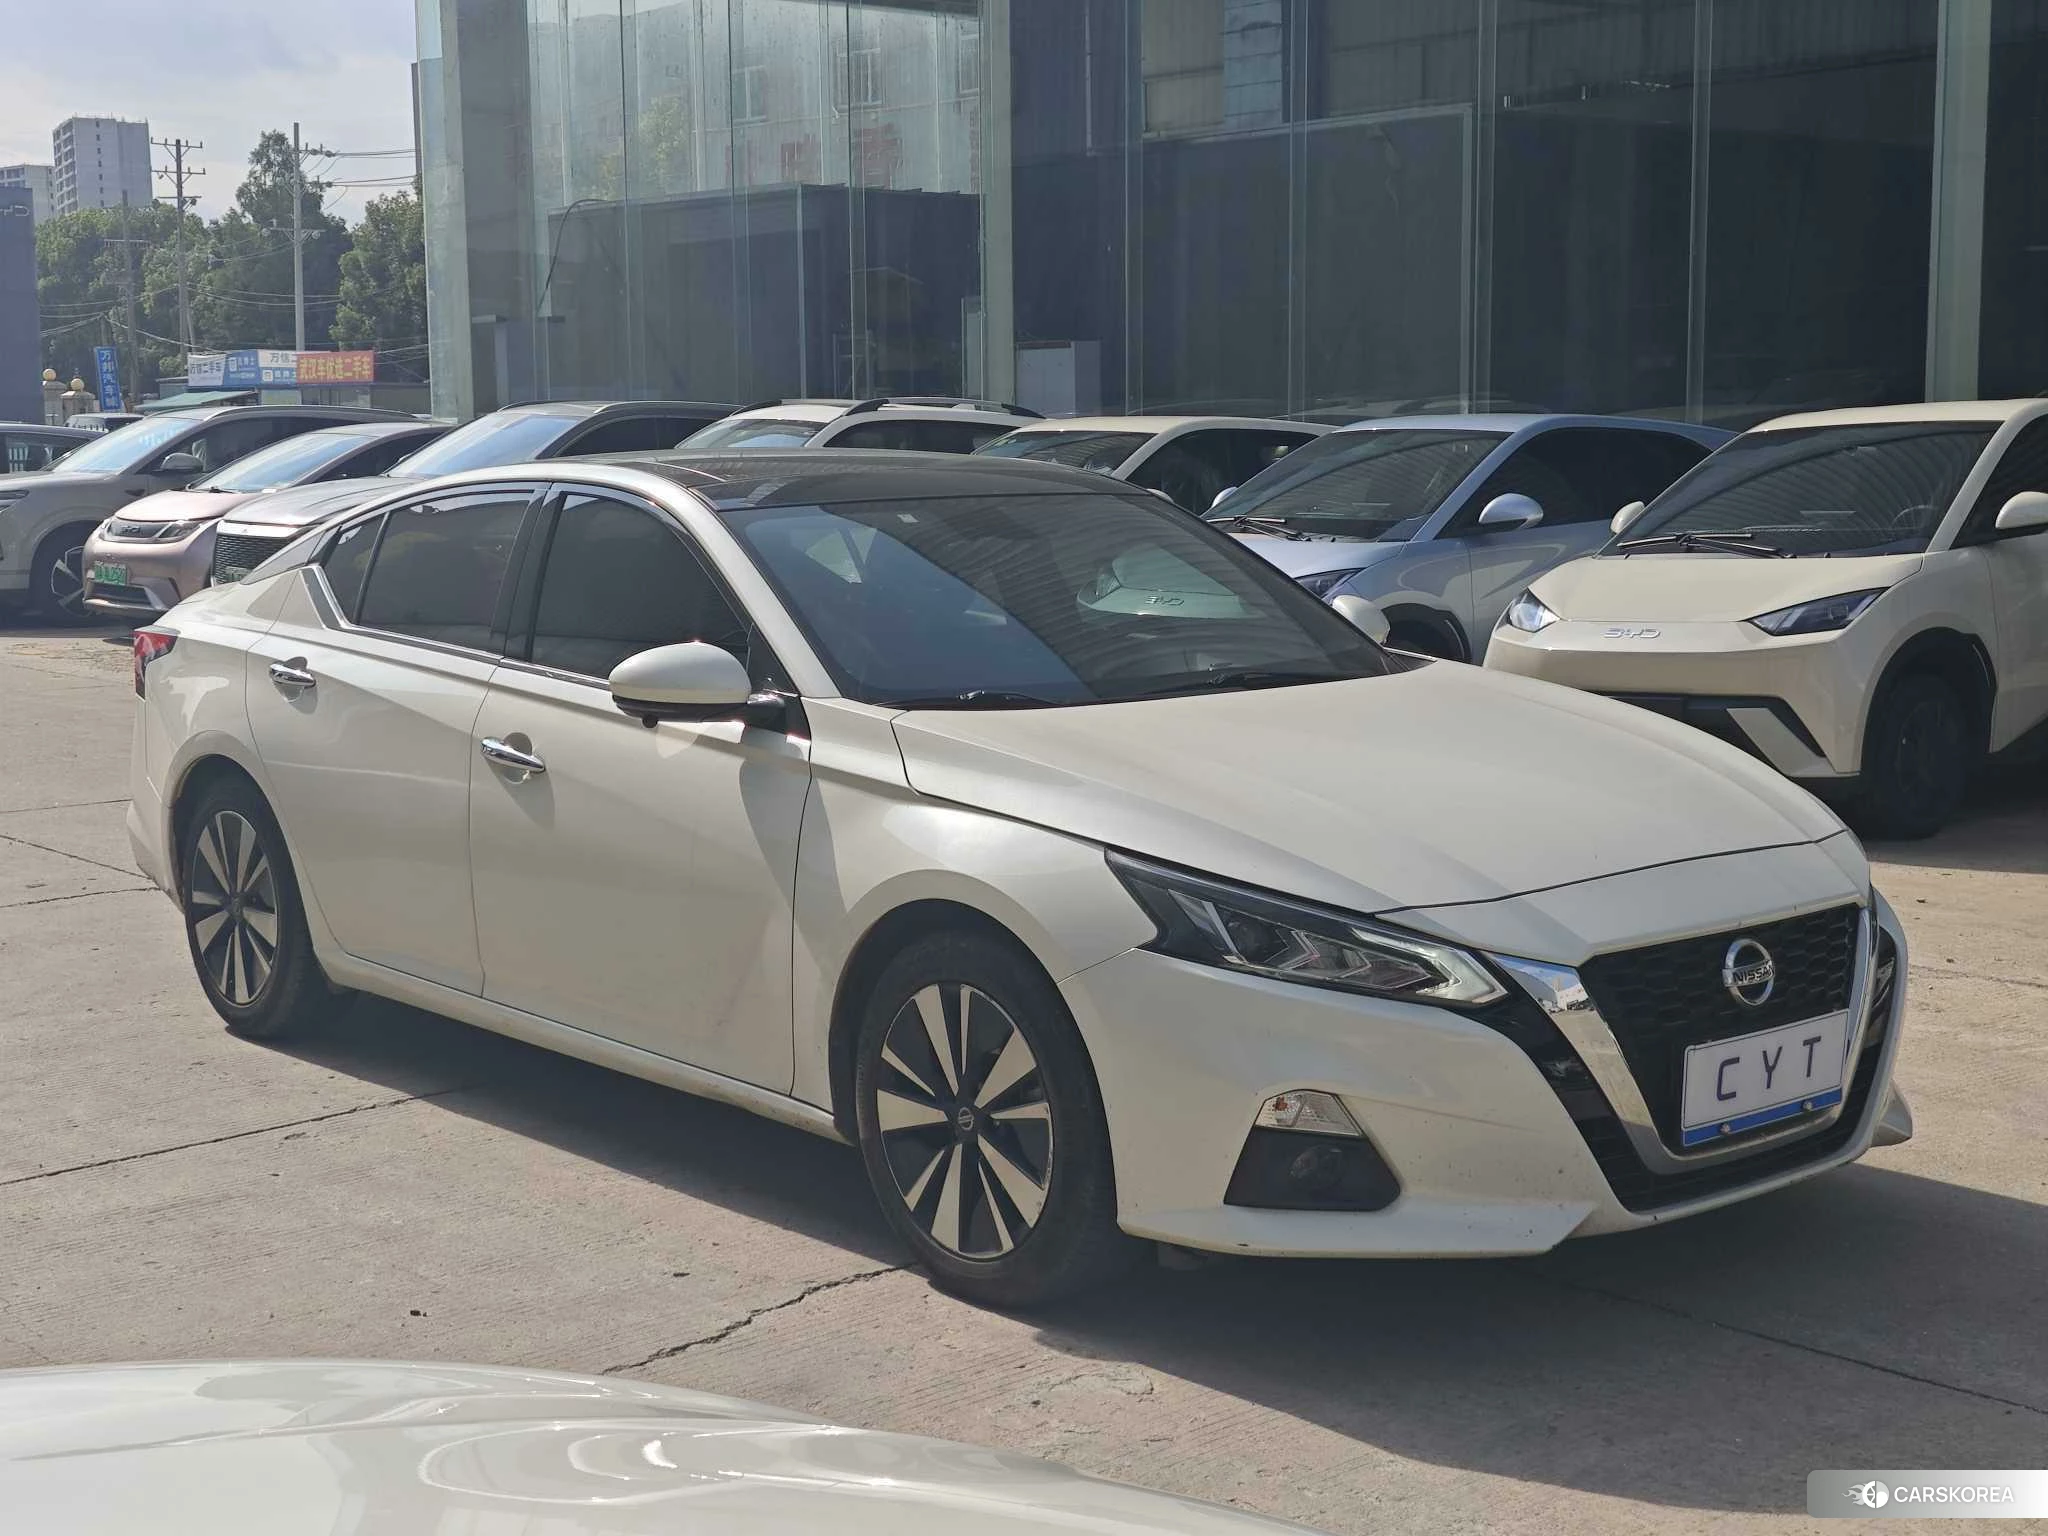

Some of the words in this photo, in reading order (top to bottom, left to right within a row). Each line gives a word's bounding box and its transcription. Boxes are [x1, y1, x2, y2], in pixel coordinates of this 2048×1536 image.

[0, 205, 30, 217] YD
[1602, 627, 1661, 639] BYD
[1732, 965, 1775, 984] NISSAN
